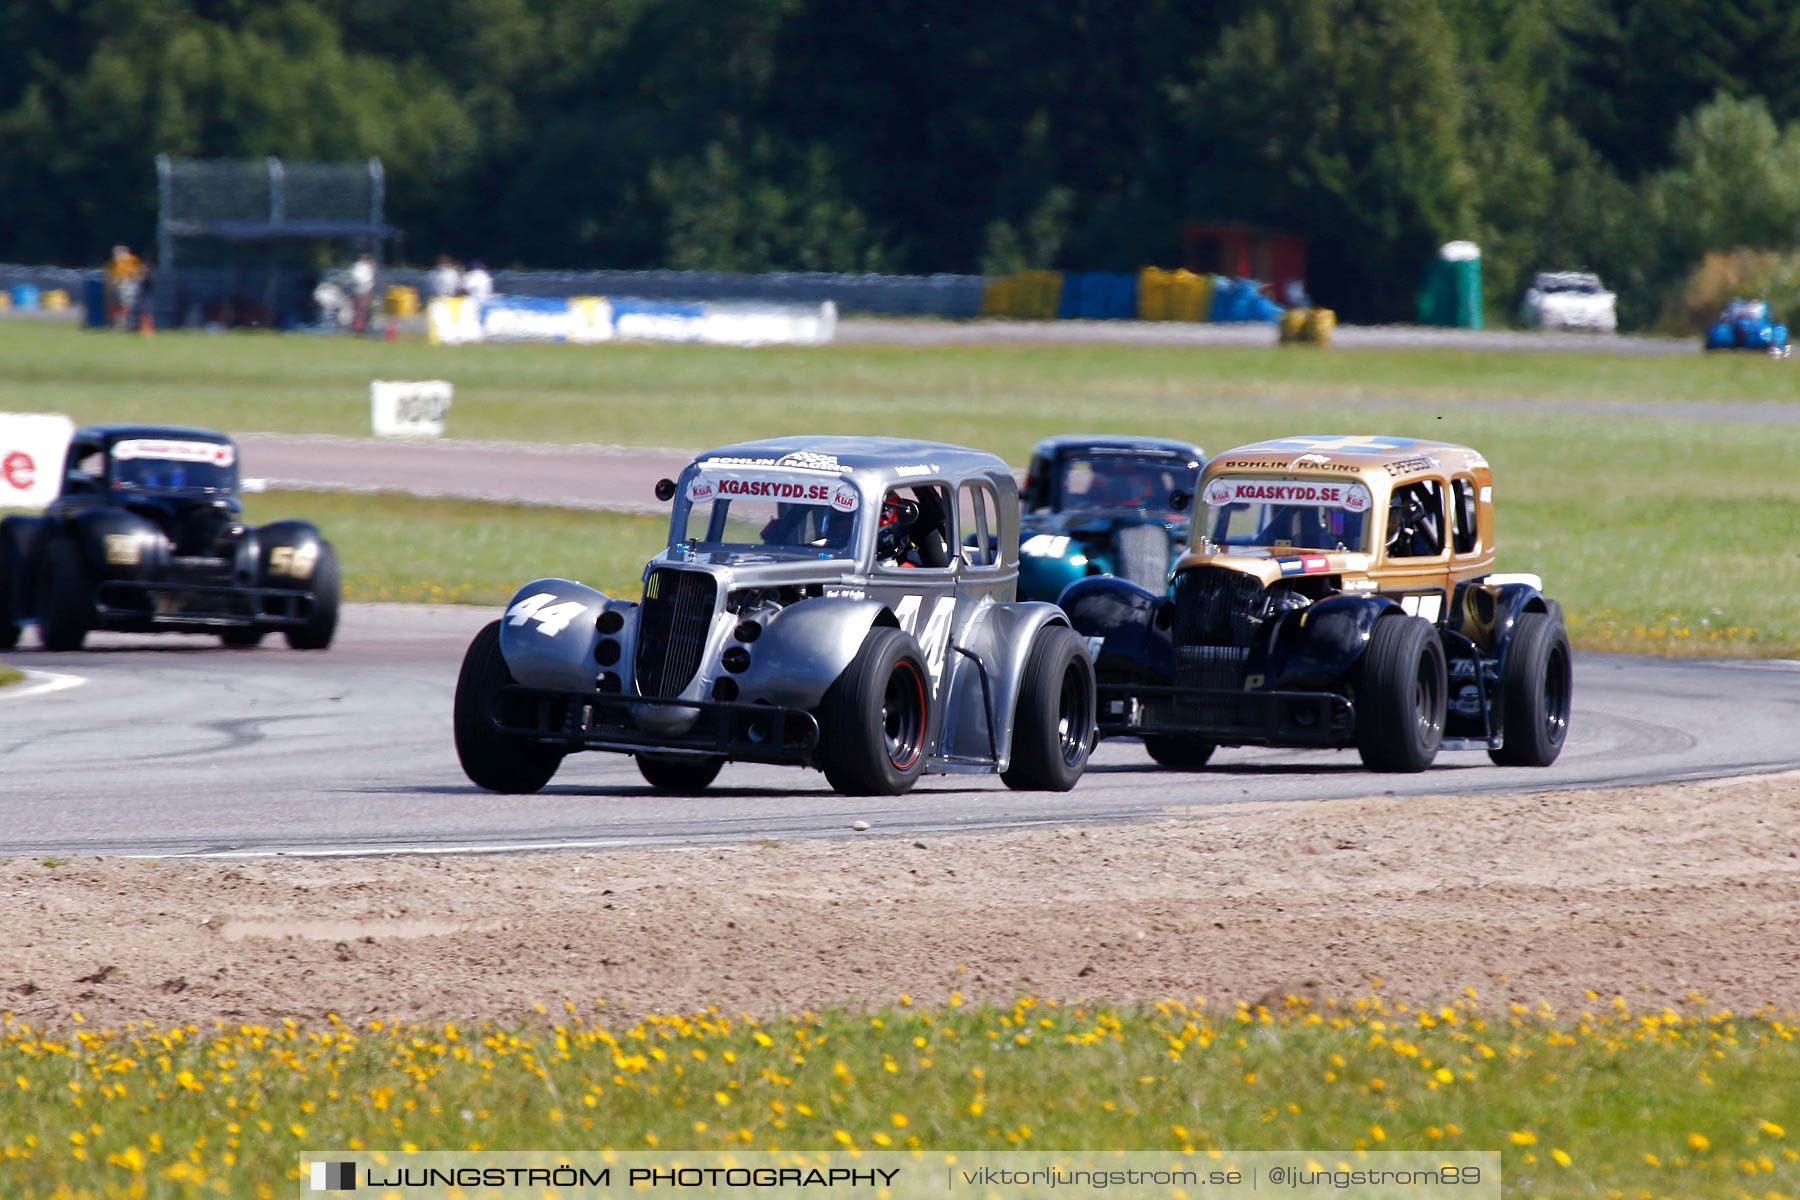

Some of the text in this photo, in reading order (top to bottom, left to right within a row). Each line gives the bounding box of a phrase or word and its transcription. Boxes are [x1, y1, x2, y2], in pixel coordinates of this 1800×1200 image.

[0, 450, 36, 490] e
[707, 457, 853, 473] BOHLIN RACING
[1225, 460, 1361, 473] BOHLIN RACING
[718, 479, 829, 501] KGASKYDD.SE
[1235, 484, 1340, 502] KGASKYDD.SE
[506, 592, 589, 638] 44
